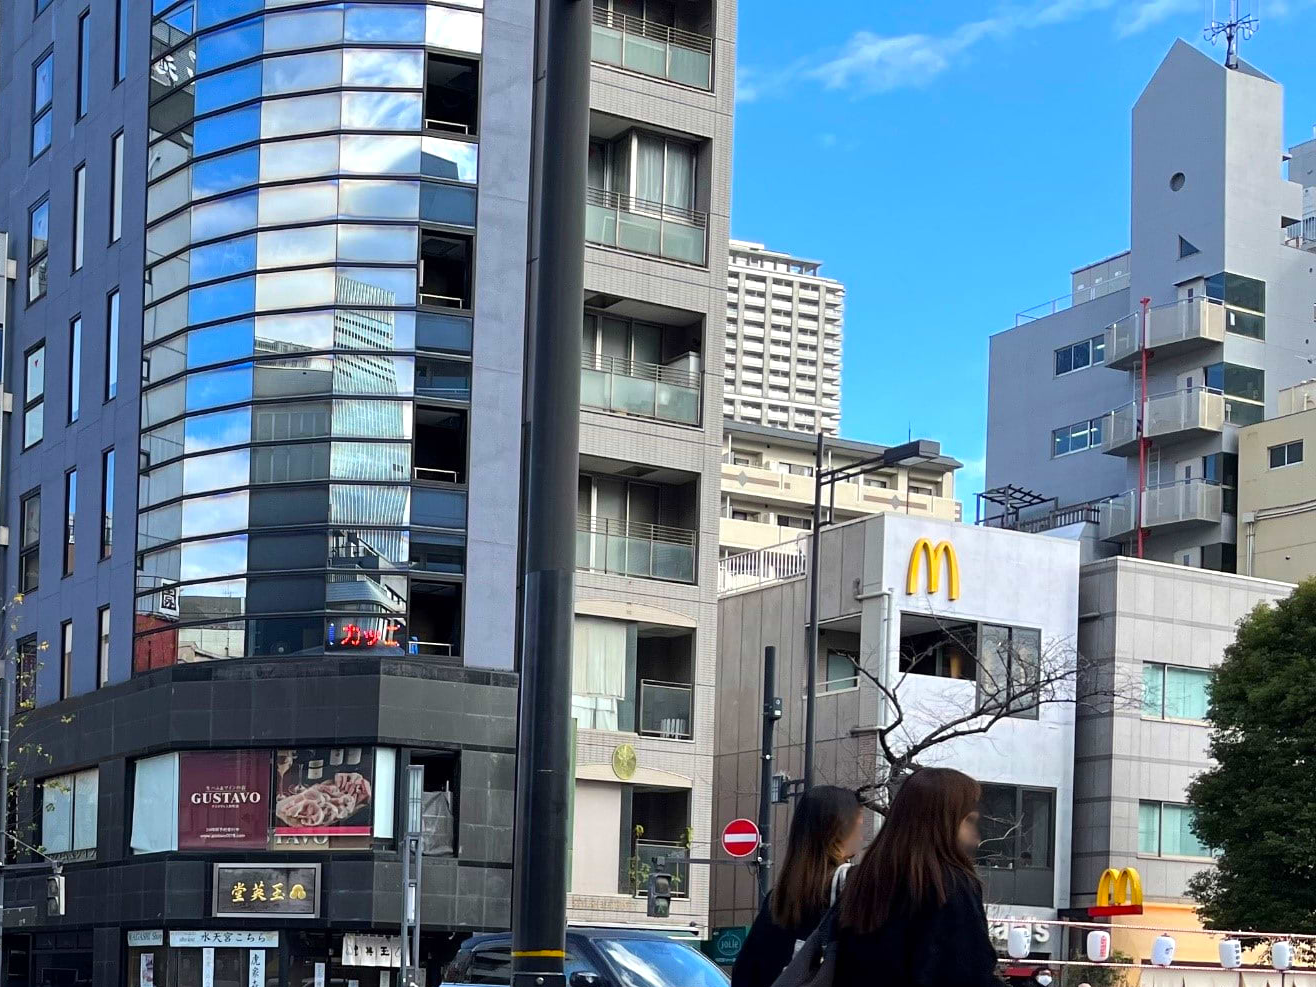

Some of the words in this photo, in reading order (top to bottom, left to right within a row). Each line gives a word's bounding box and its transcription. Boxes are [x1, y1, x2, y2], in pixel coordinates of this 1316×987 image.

[191, 791, 261, 804] GUSTAVO
[201, 931, 266, 943] 水天宮こちら
